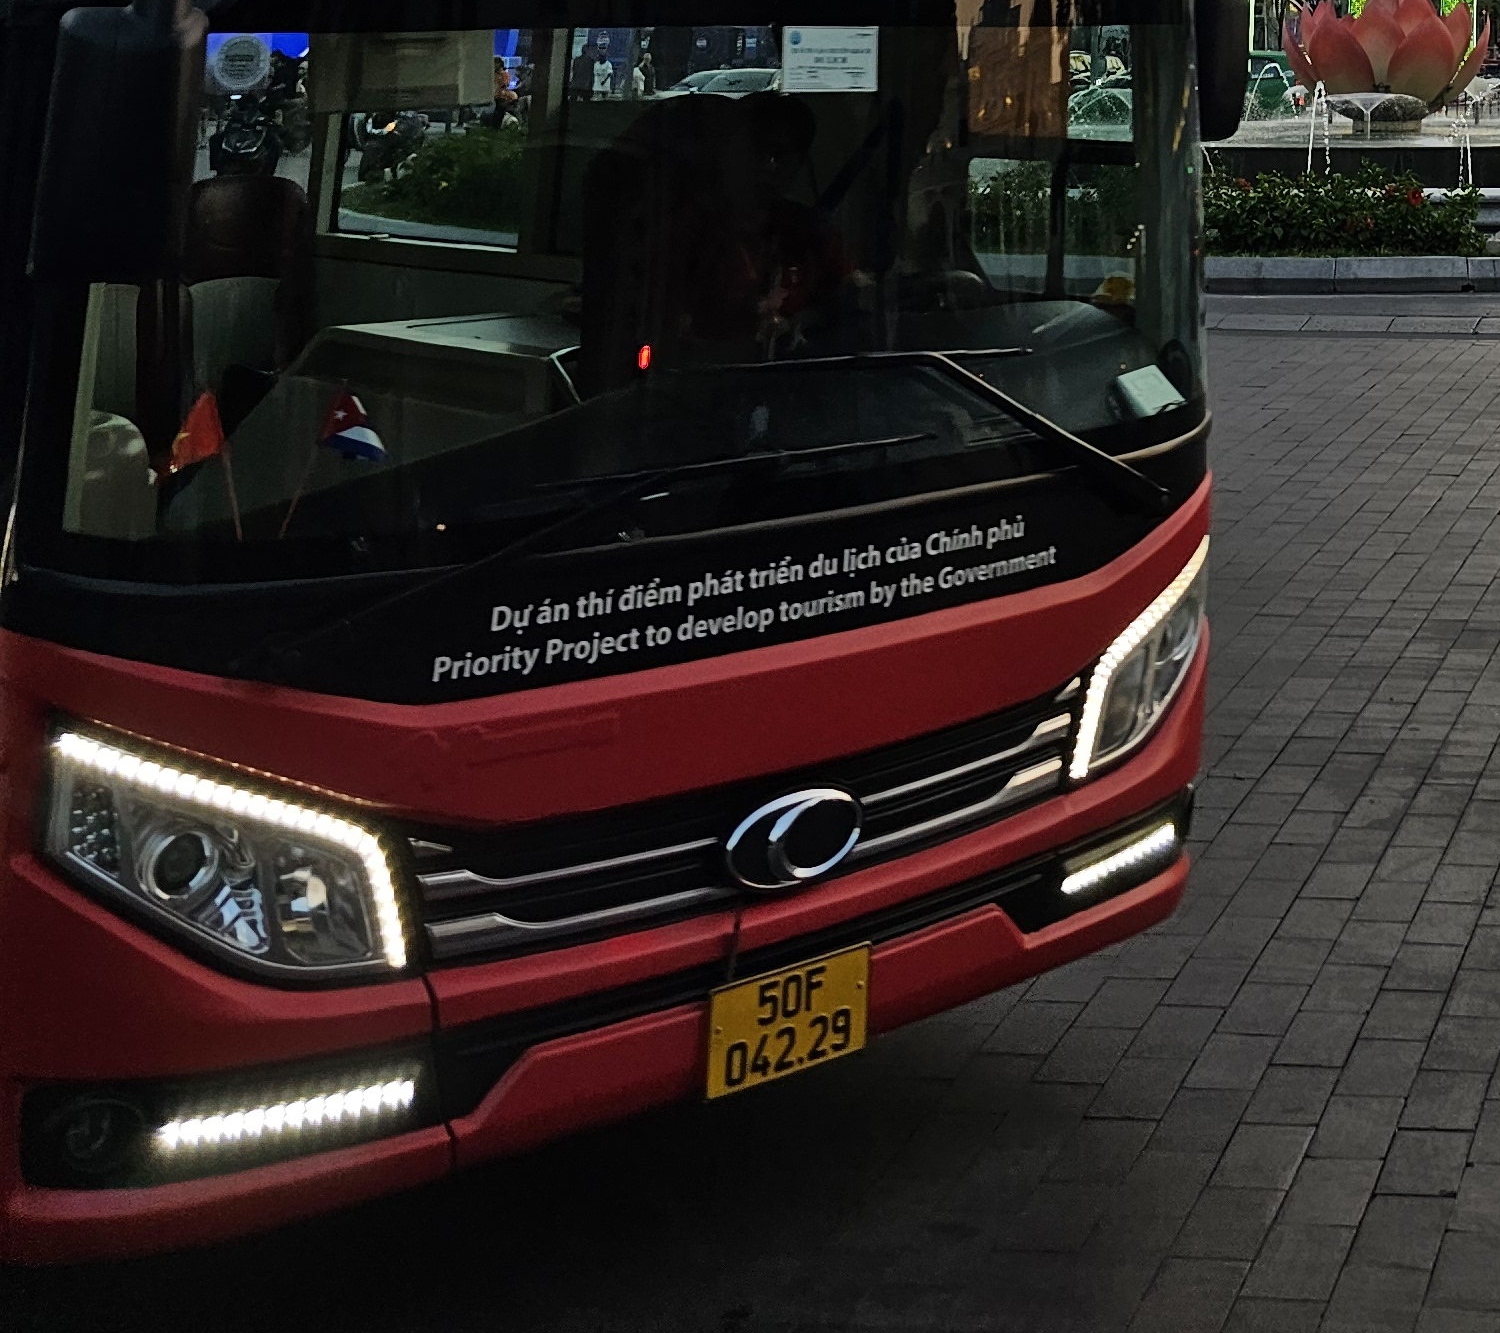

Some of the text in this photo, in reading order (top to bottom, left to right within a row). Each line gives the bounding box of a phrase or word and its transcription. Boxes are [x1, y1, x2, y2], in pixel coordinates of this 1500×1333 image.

[432, 545, 1057, 683] Priority Project to develop tourism by the Government
[490, 514, 1026, 635] Dự án thí điểm phát triển du lịch của Chính phủ
[757, 964, 827, 1026] 50F
[724, 1007, 852, 1086] 042.29
